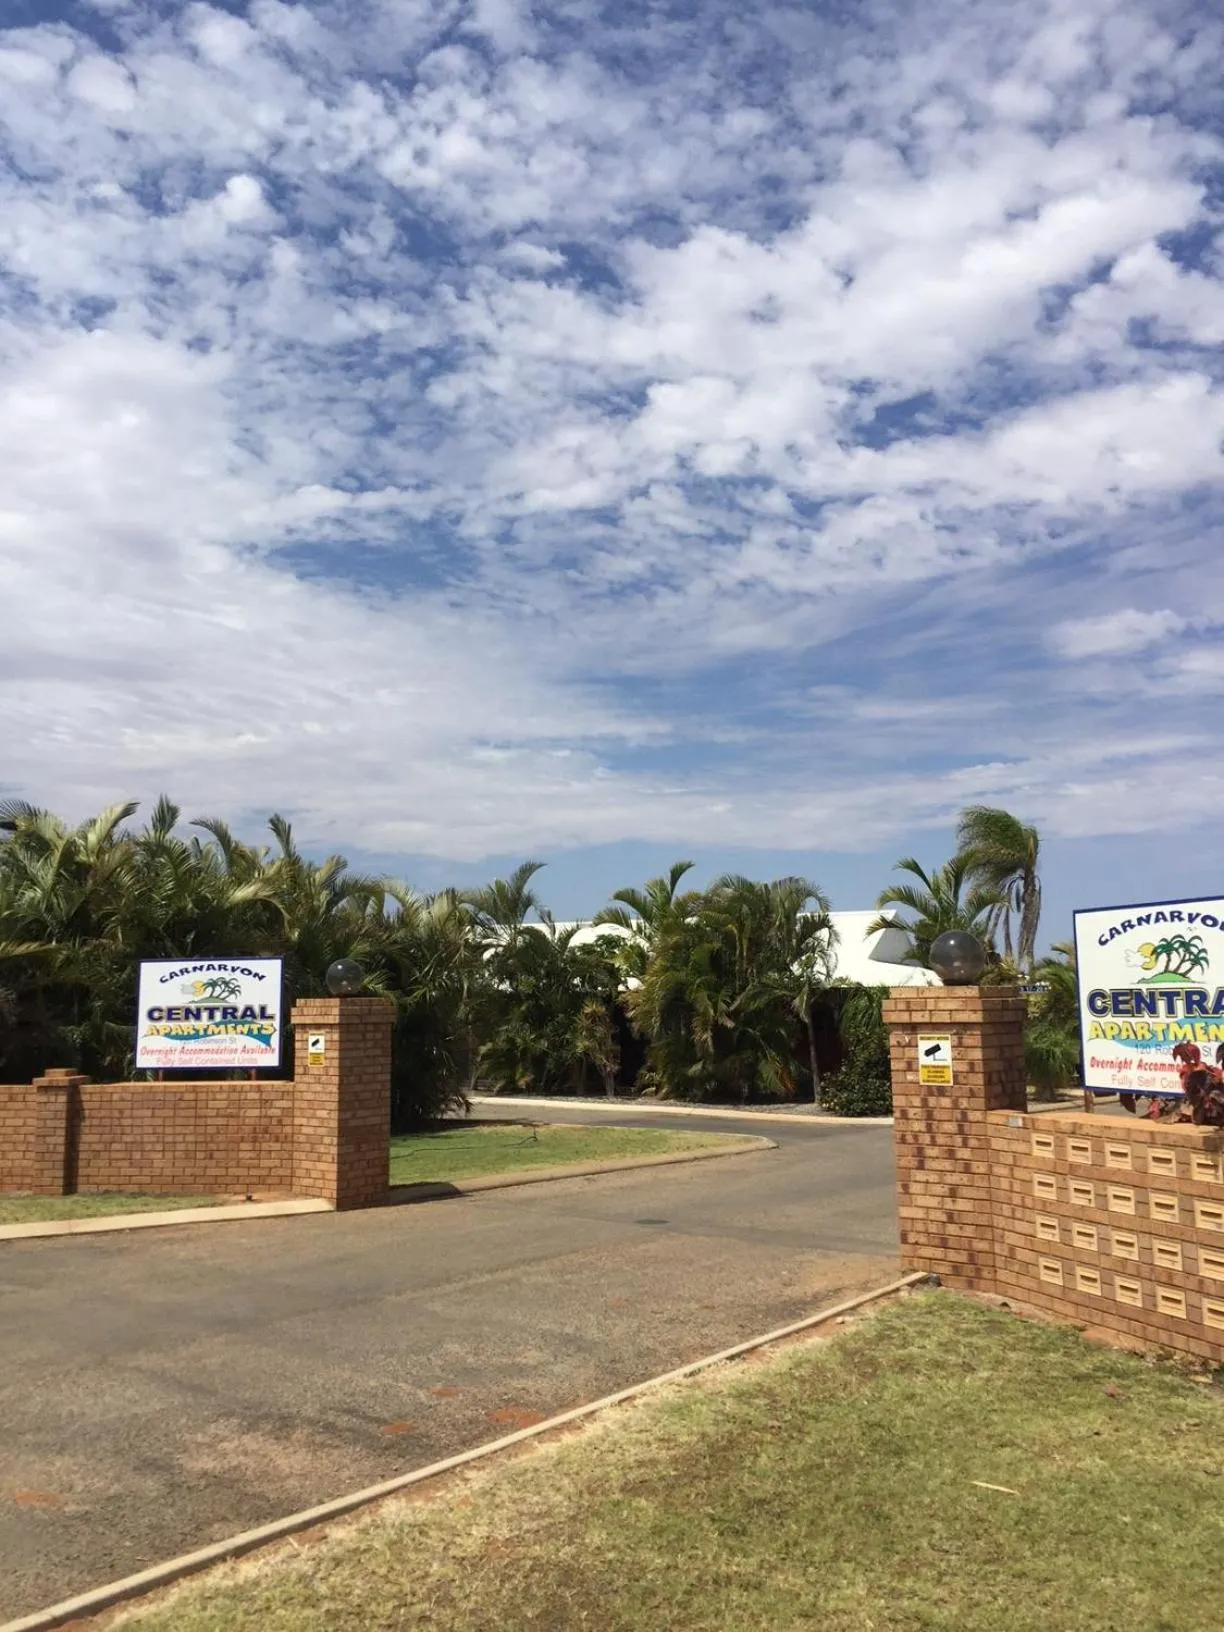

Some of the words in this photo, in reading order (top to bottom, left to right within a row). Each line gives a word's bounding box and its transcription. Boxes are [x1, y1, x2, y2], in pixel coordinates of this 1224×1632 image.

[160, 963, 266, 984] CARNARVON
[1087, 987, 1224, 1019] CENTRA
[147, 1004, 276, 1022] CENTRAL
[147, 1022, 277, 1037] APARTMENTS
[1089, 1021, 1224, 1042] APARTMEN
[1090, 1056, 1133, 1073] Overnight
[1137, 1058, 1181, 1073] Accommo
[1111, 1074, 1132, 1088] Fully
[1137, 1076, 1156, 1088] Self
